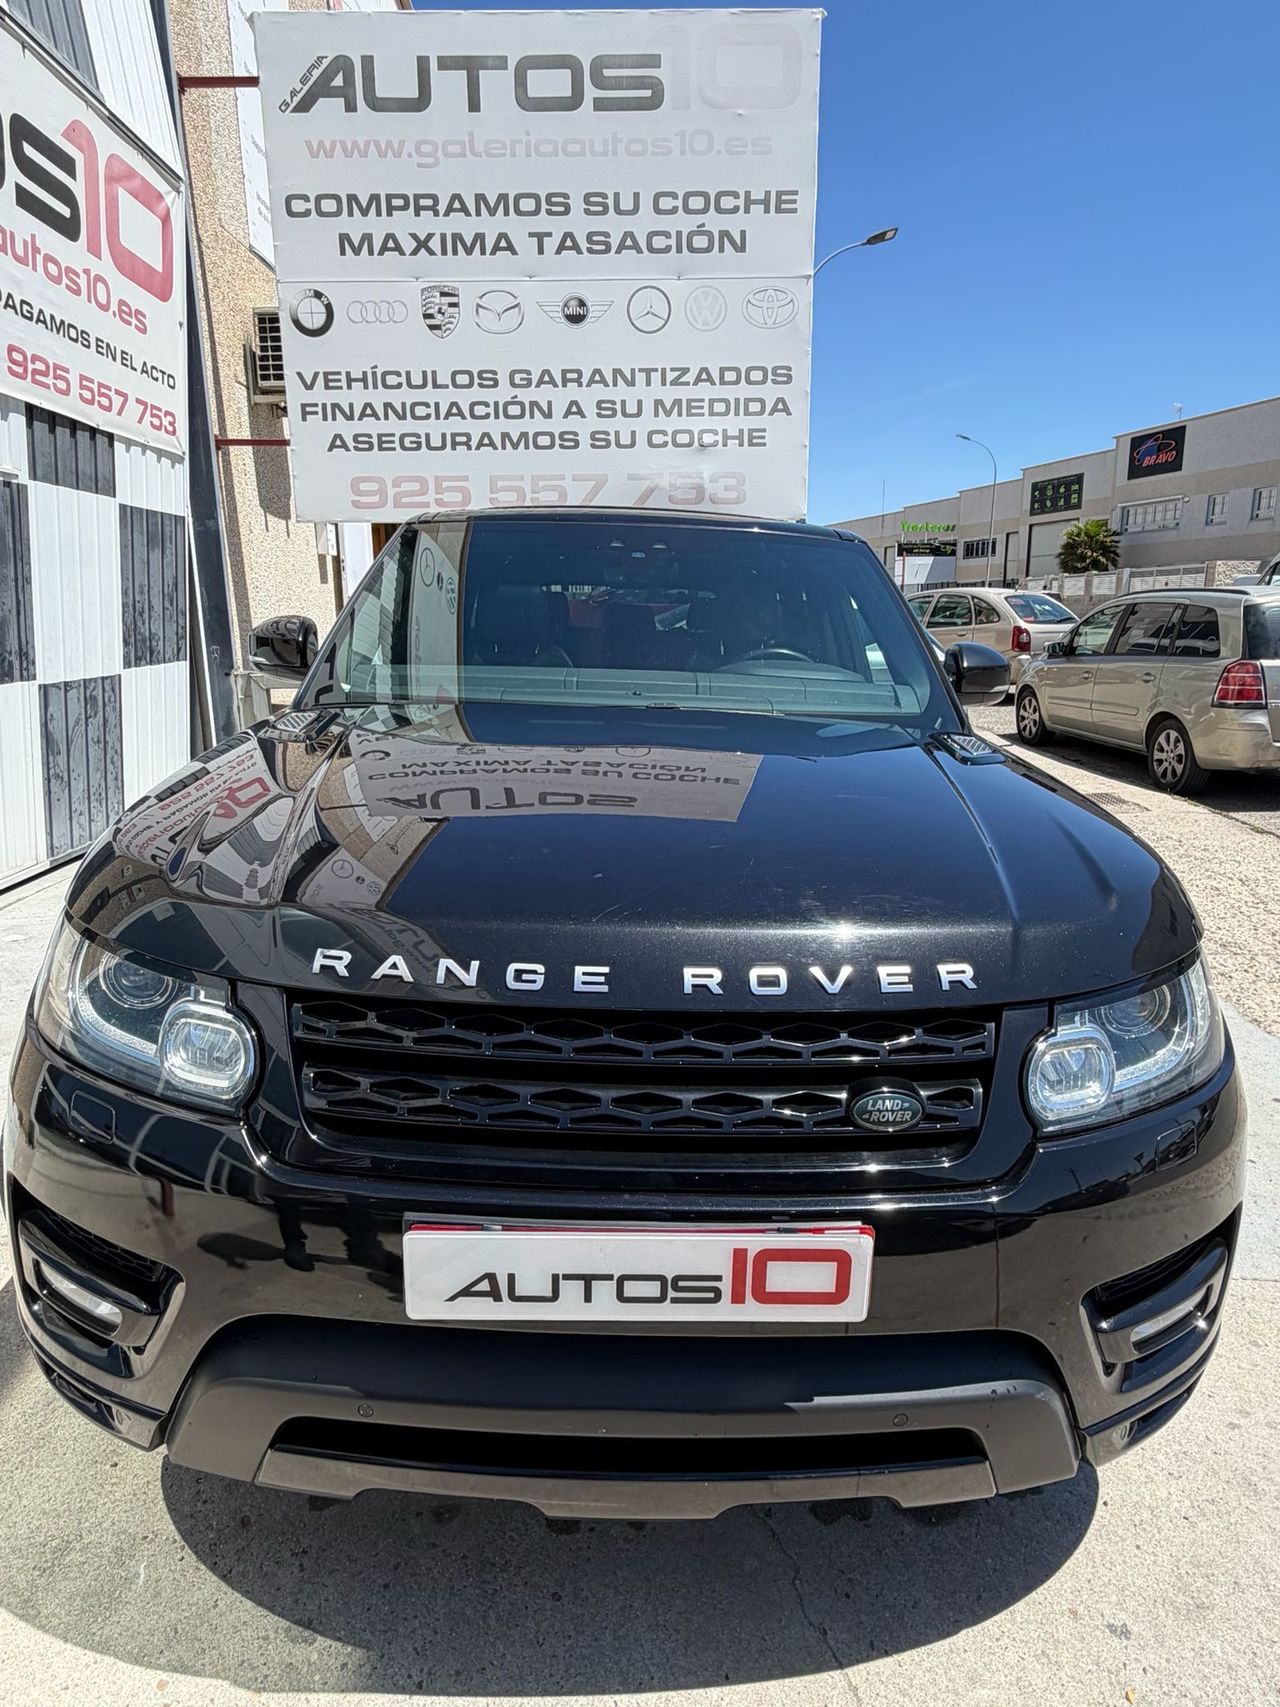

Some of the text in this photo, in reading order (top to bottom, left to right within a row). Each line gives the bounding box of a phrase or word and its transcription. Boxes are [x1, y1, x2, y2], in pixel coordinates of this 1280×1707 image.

[279, 55, 329, 113] GALERIA
[304, 128, 773, 168] www.galeriaautos10.es
[0, 110, 174, 303] S10
[284, 191, 571, 218] COMPRAMOS
[583, 191, 641, 217] SU
[652, 189, 799, 217] COCHE
[338, 222, 748, 257] MAXIMA TASACIÓN
[564, 306, 587, 317] MINI
[0, 290, 176, 391] AGAMOS EN EL ACTO
[6, 343, 178, 437] 925 557 753
[295, 364, 794, 391] VEHÍCULOS GARANTIZADOS
[299, 395, 793, 422] FINANCIACIÓN A SU MEDIDA
[327, 427, 768, 453] ASEGURAMOS SU COCHE
[1142, 450, 1177, 467] BRAVO
[350, 471, 748, 511] 925 557 753
[312, 948, 978, 995] RANGE ROVER
[867, 1099, 902, 1111] LAND
[870, 1110, 912, 1122] ROVER
[443, 1247, 853, 1306] AUTOS10
